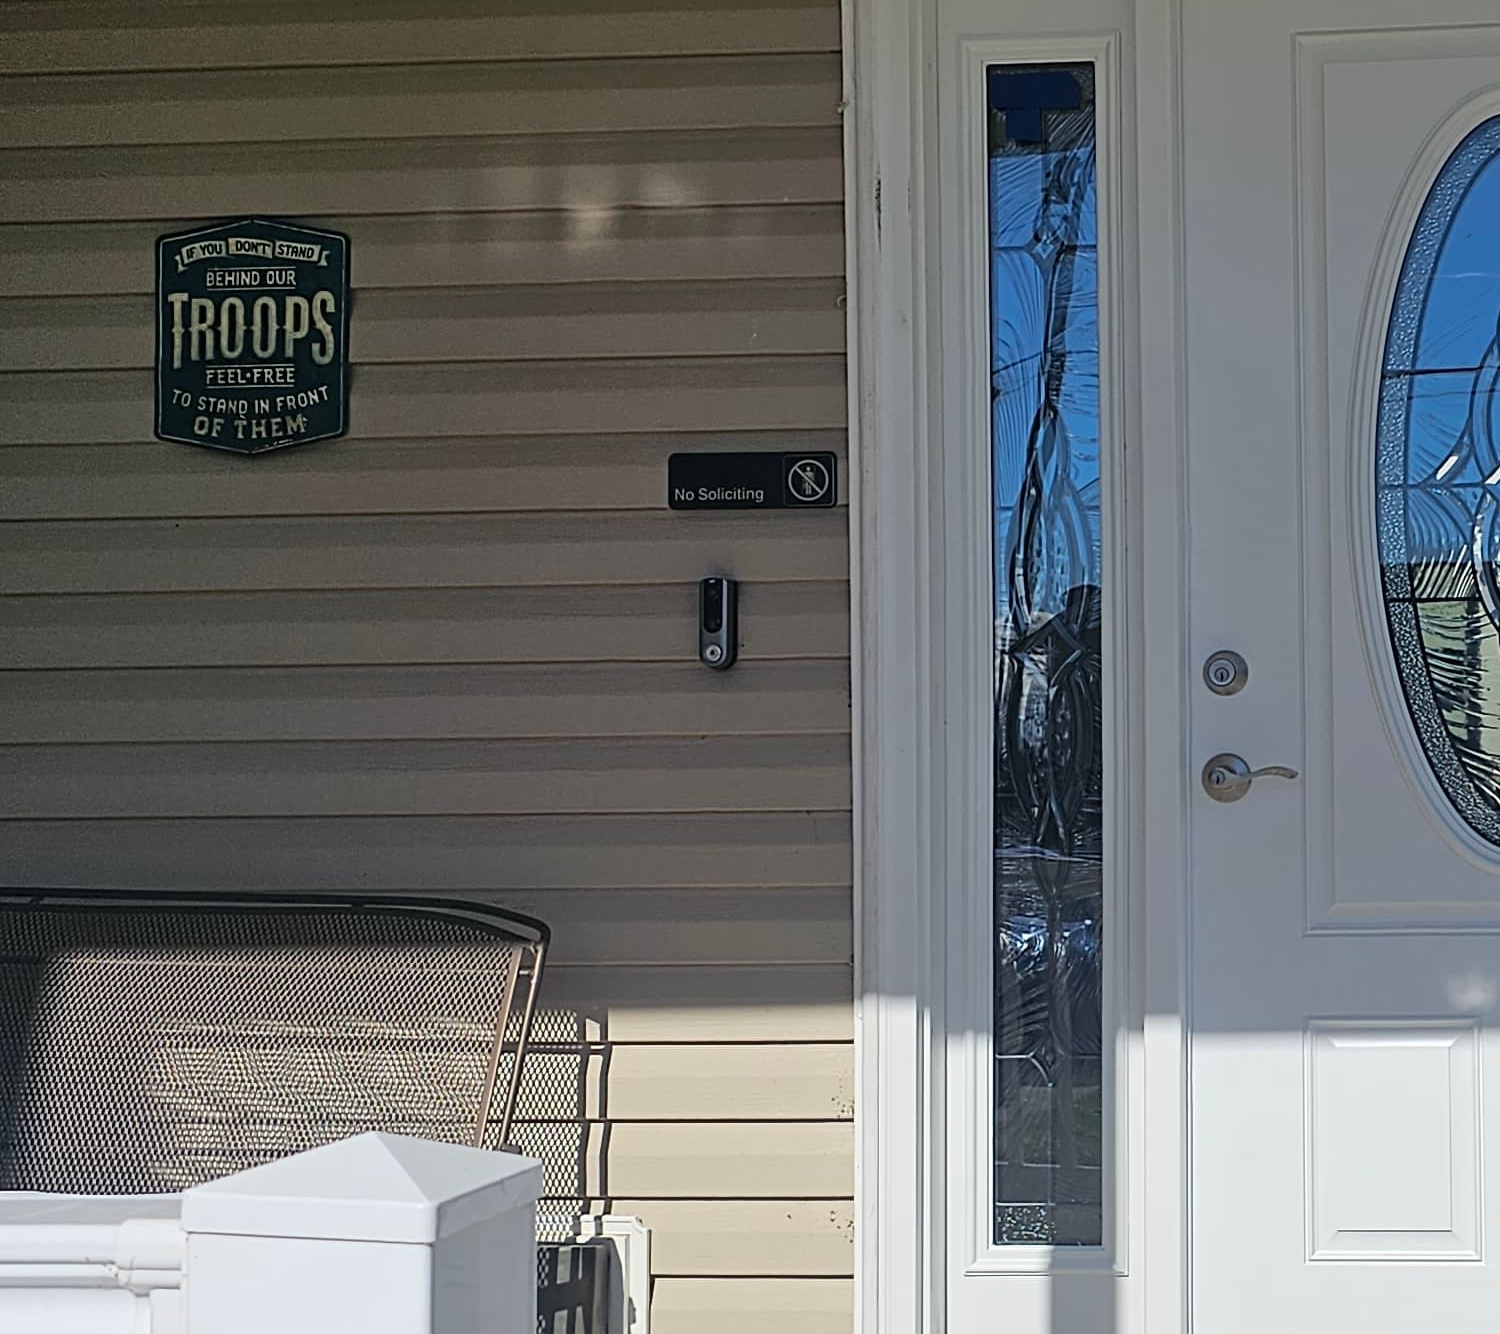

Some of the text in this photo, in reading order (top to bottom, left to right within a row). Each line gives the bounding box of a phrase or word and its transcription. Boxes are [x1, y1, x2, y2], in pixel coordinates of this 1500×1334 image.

[186, 239, 315, 260] IF YOU DON'T STAND
[206, 270, 297, 287] BEHIND OUR
[168, 290, 335, 369] TROOPS
[172, 385, 329, 415] TO STAND IN FRONT
[194, 415, 225, 437] OF
[674, 487, 764, 503] No Soliciting
